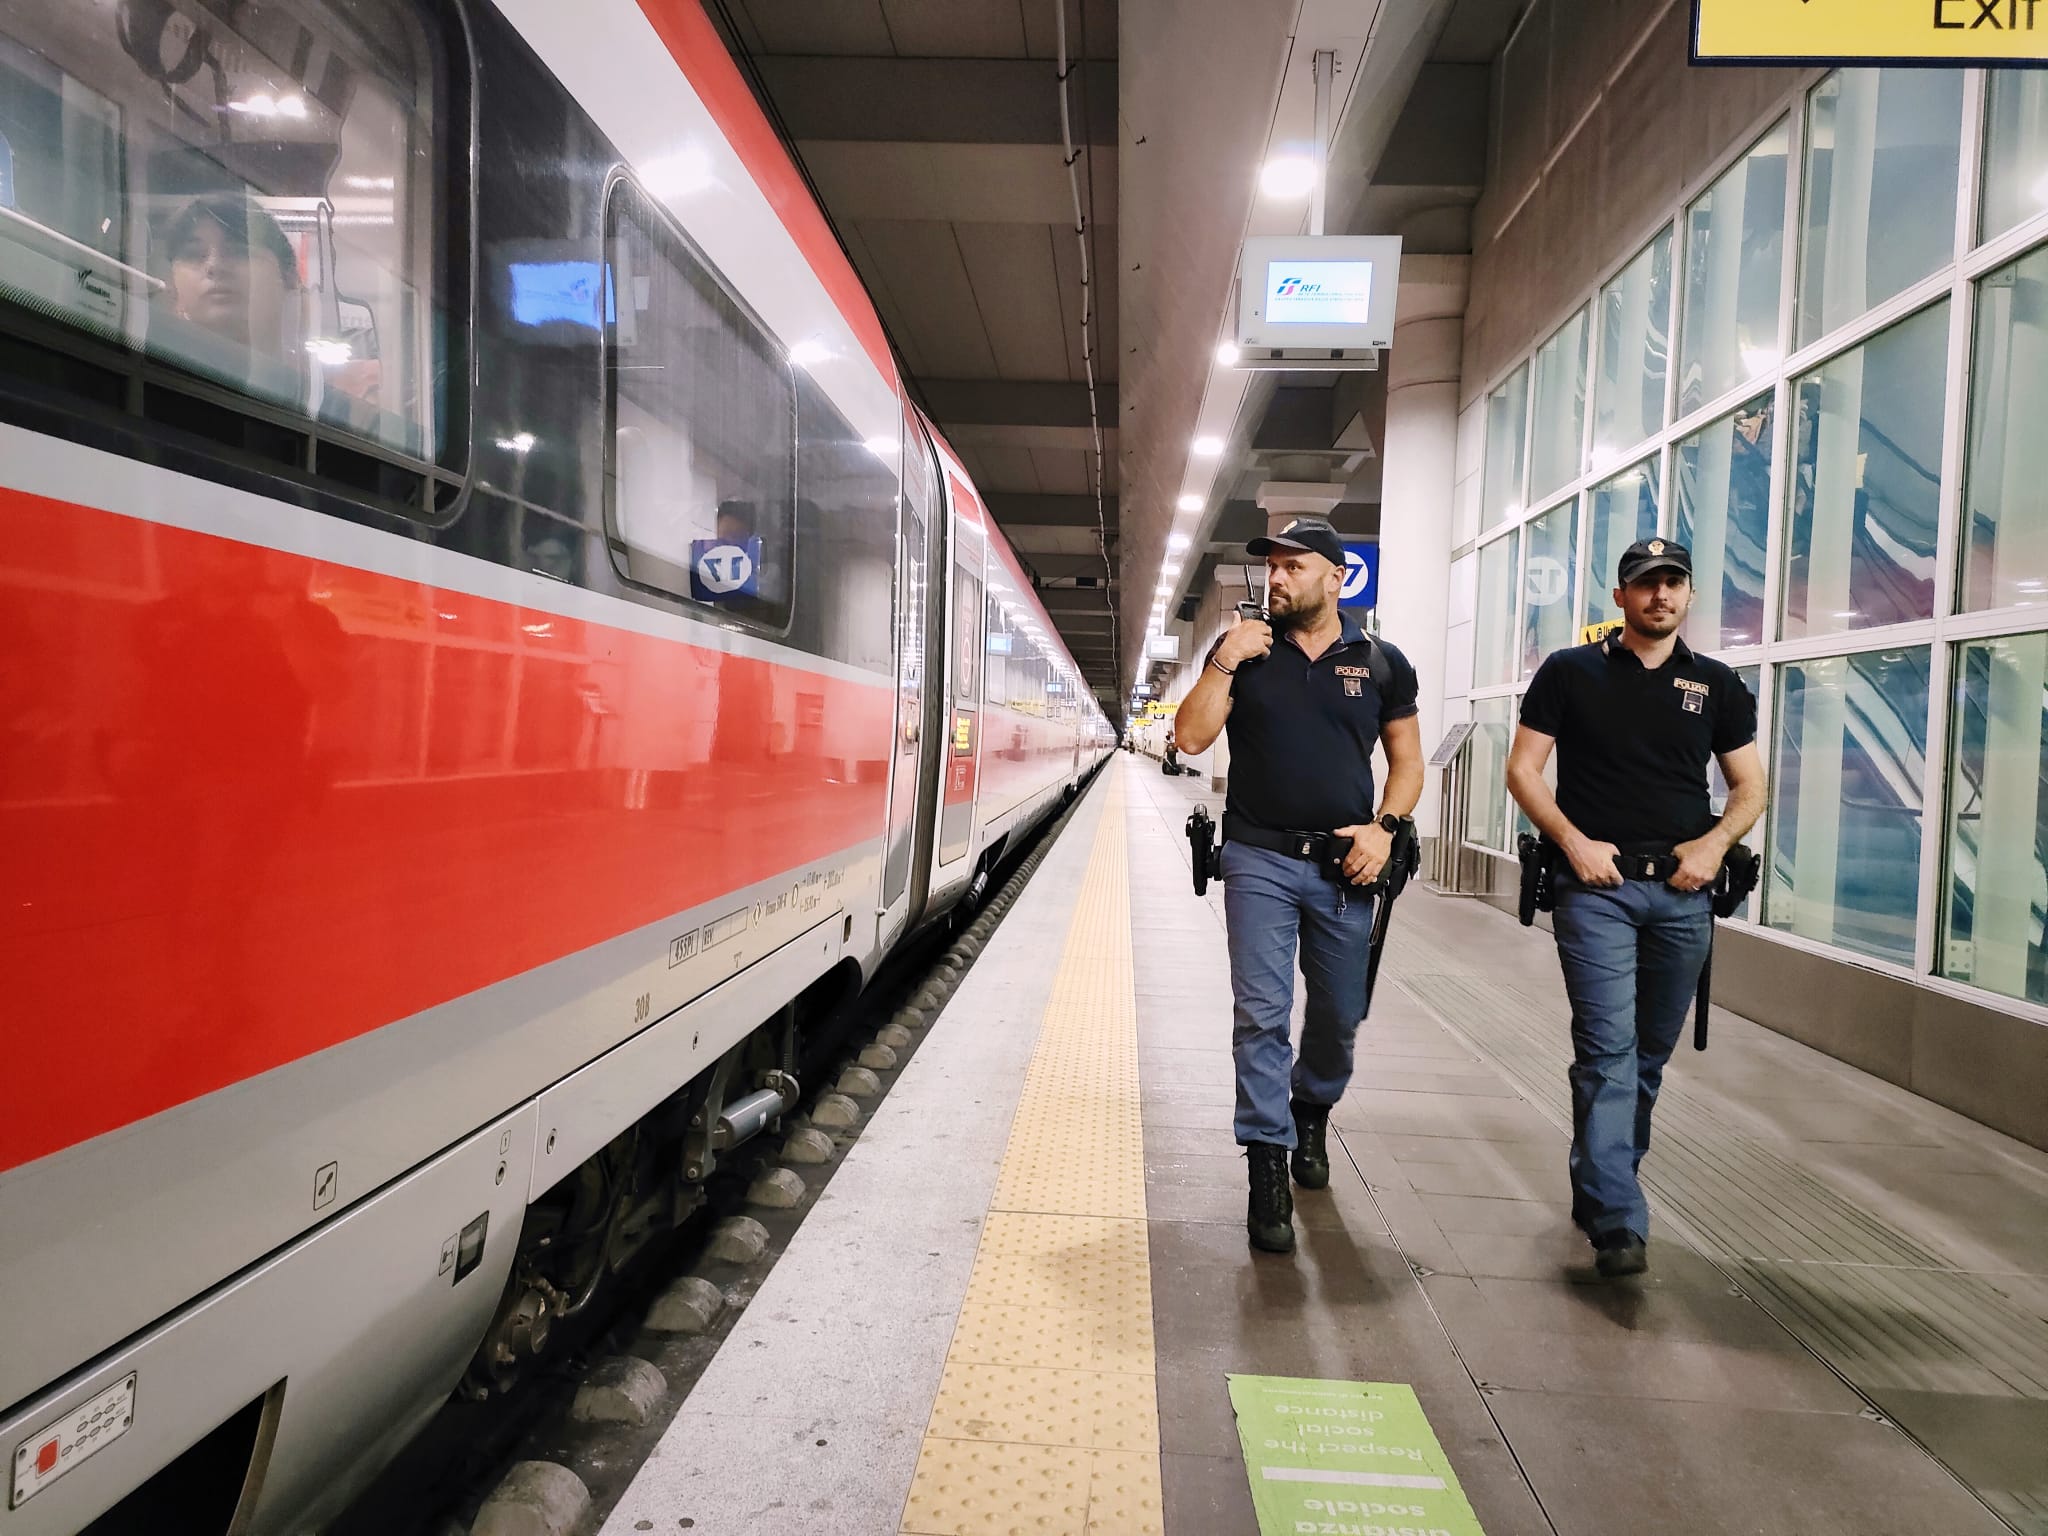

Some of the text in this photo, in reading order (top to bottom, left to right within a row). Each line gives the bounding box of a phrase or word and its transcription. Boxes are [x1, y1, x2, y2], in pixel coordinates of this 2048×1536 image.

[1300, 284, 1321, 292] RFI
[1336, 667, 1369, 677] POLIZIA
[1675, 679, 1708, 694] POLIZIA
[634, 992, 650, 1023] 308
[1274, 1404, 1383, 1423] distance
[1297, 1423, 1375, 1437] social
[1263, 1439, 1423, 1461] Respect the
[1303, 1499, 1426, 1517] sociale
